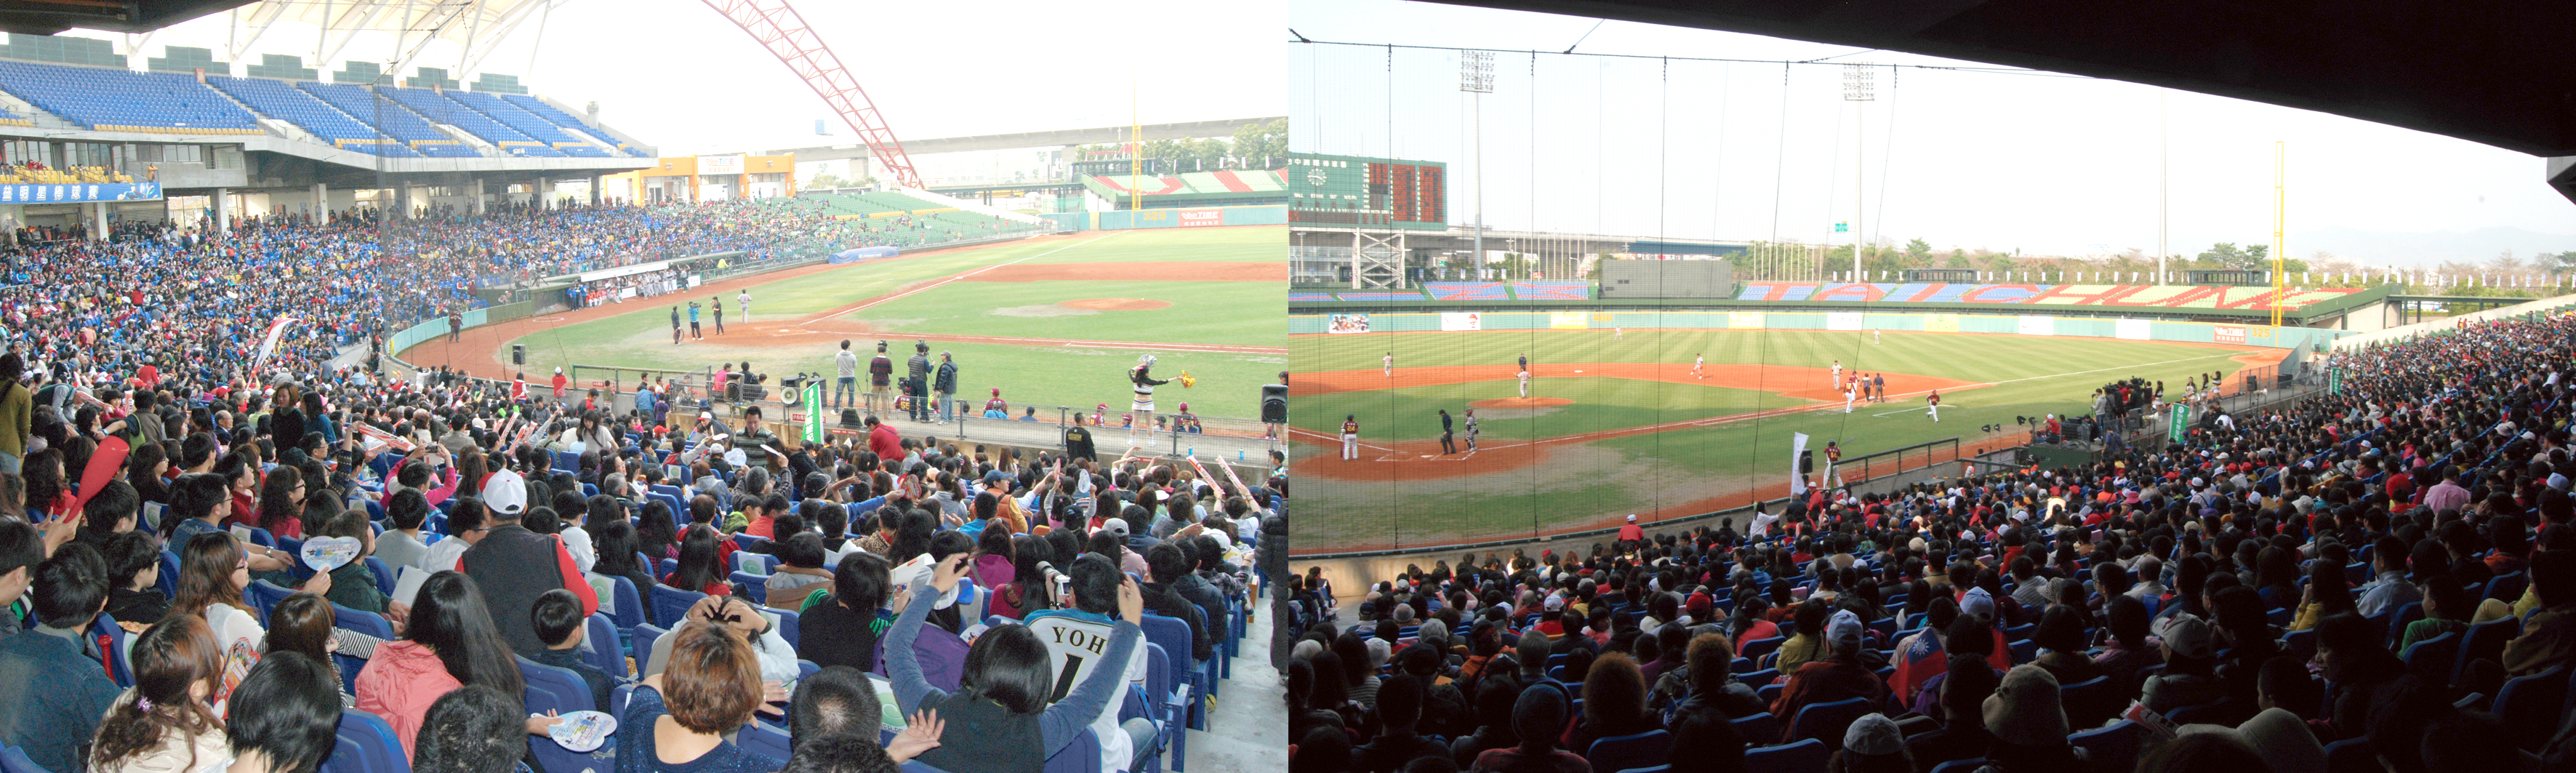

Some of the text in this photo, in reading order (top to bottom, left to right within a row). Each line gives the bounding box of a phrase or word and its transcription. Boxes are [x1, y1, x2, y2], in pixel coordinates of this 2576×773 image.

[2, 185, 99, 201] 益明星棒球賽
[1144, 211, 1166, 221] 325
[2252, 328, 2270, 338] 325
[1052, 626, 1107, 655] YOH
